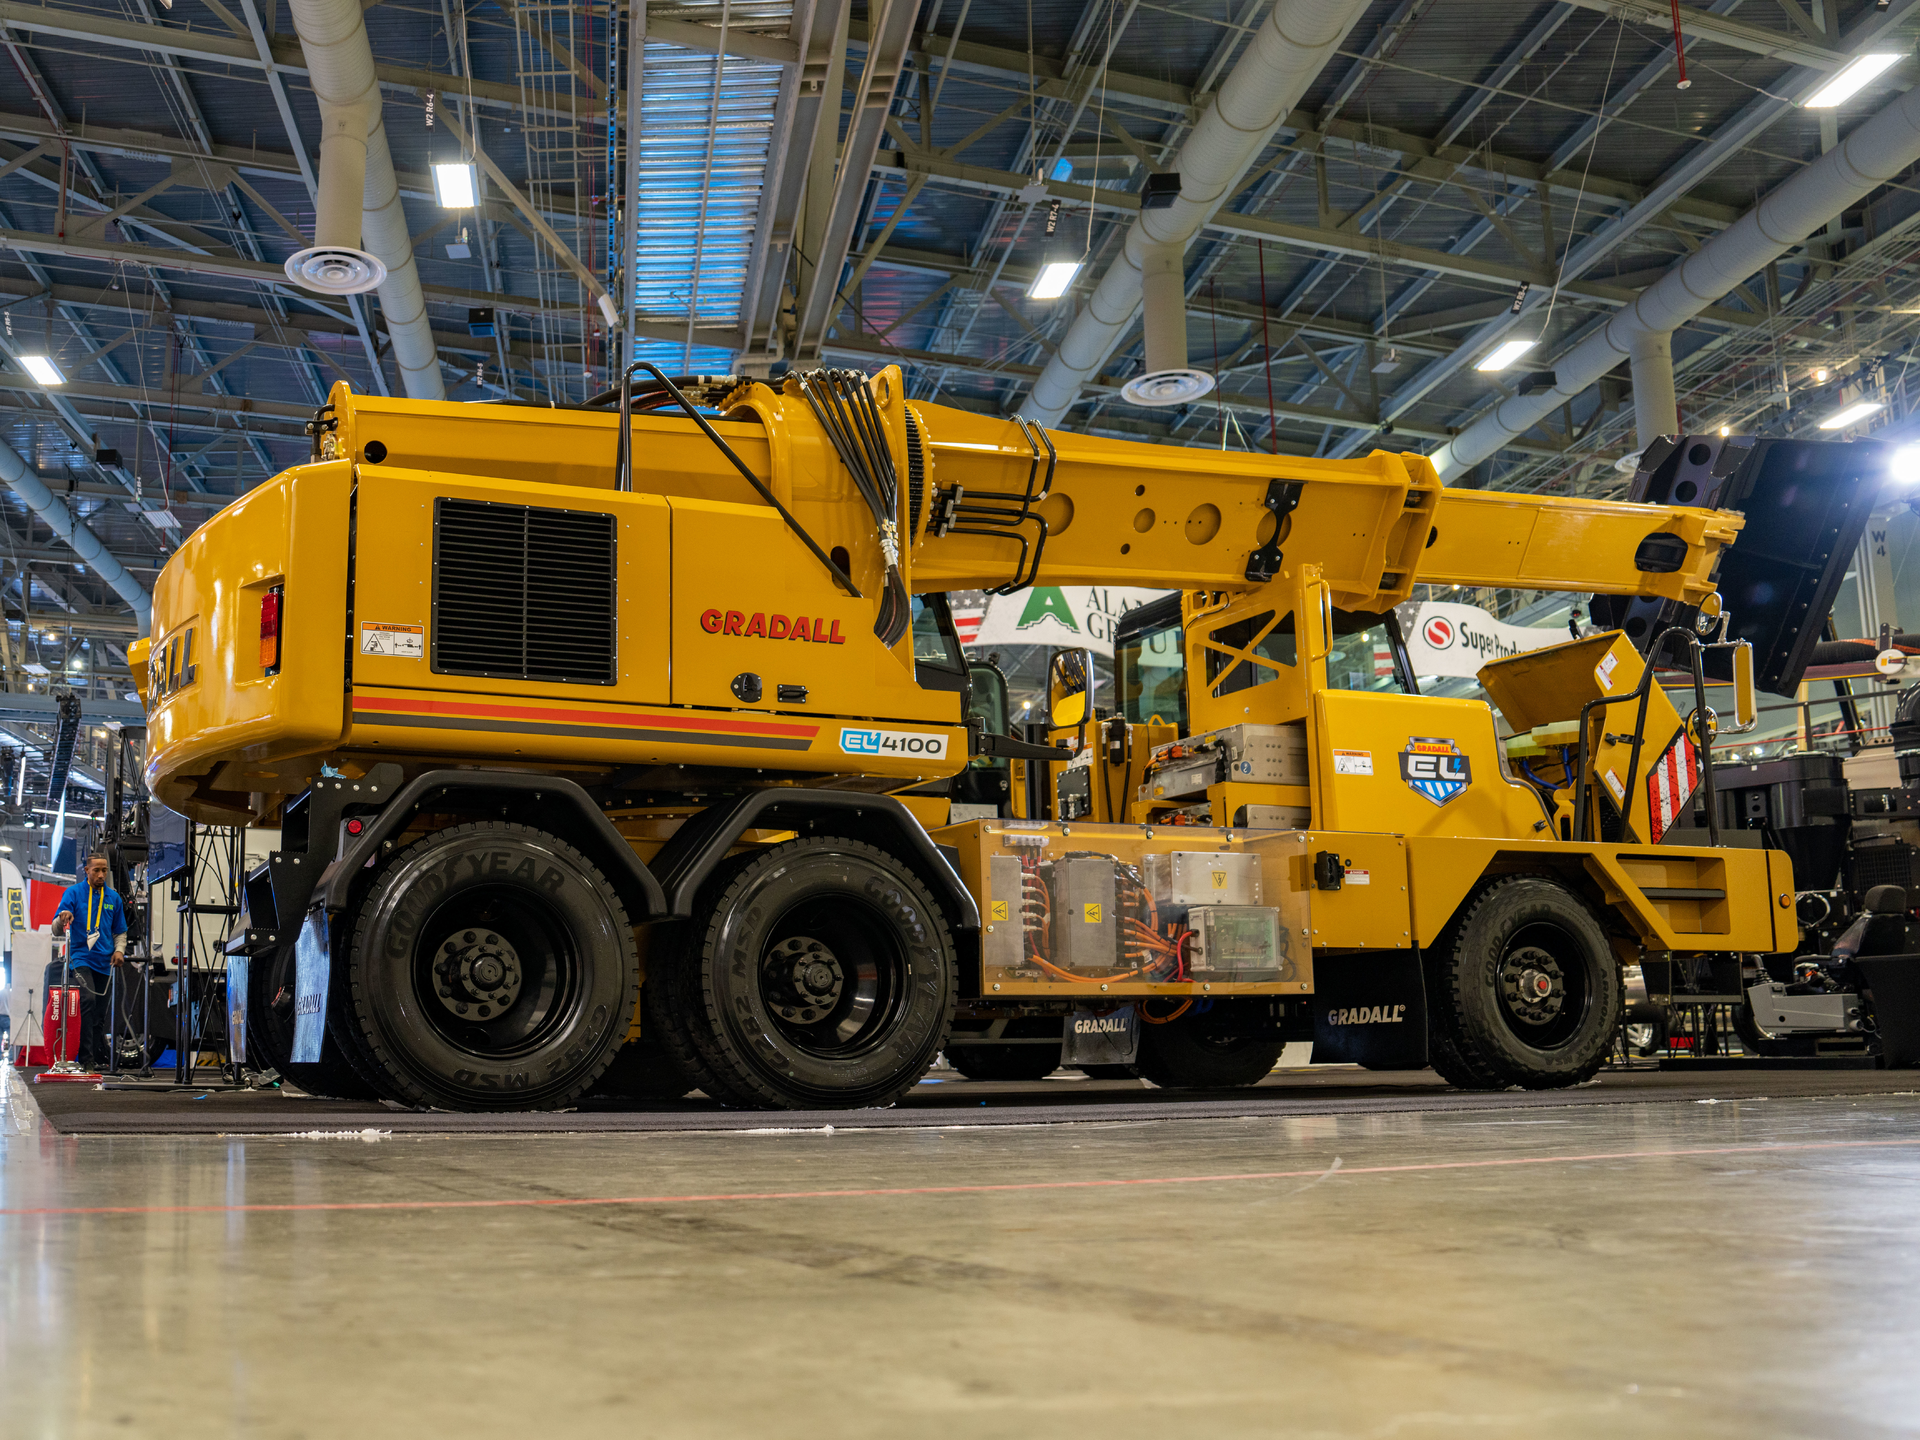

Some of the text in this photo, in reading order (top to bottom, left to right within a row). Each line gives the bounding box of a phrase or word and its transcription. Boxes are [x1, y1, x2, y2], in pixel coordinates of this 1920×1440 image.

[426, 93, 434, 126] W2 R6-4
[1046, 204, 1060, 232] W2 R7-4
[1512, 300, 1522, 310] W2
[1871, 530, 1886, 543] W
[1877, 545, 1886, 557] 4
[701, 608, 847, 645] GRADALL
[1460, 622, 1526, 659] Super Prod
[844, 733, 942, 754] EL 4100
[1416, 744, 1450, 754] GRADALL
[1407, 754, 1466, 780] EL
[385, 851, 565, 960] GOODYEAR
[731, 905, 791, 1070] G282 MSD
[1598, 967, 1610, 1028] ARMOR
[51, 990, 60, 1021] Sanitaire
[1074, 1018, 1129, 1034] GRADALL
[1575, 1031, 1599, 1061] MAX
[452, 1067, 531, 1089] MSD
